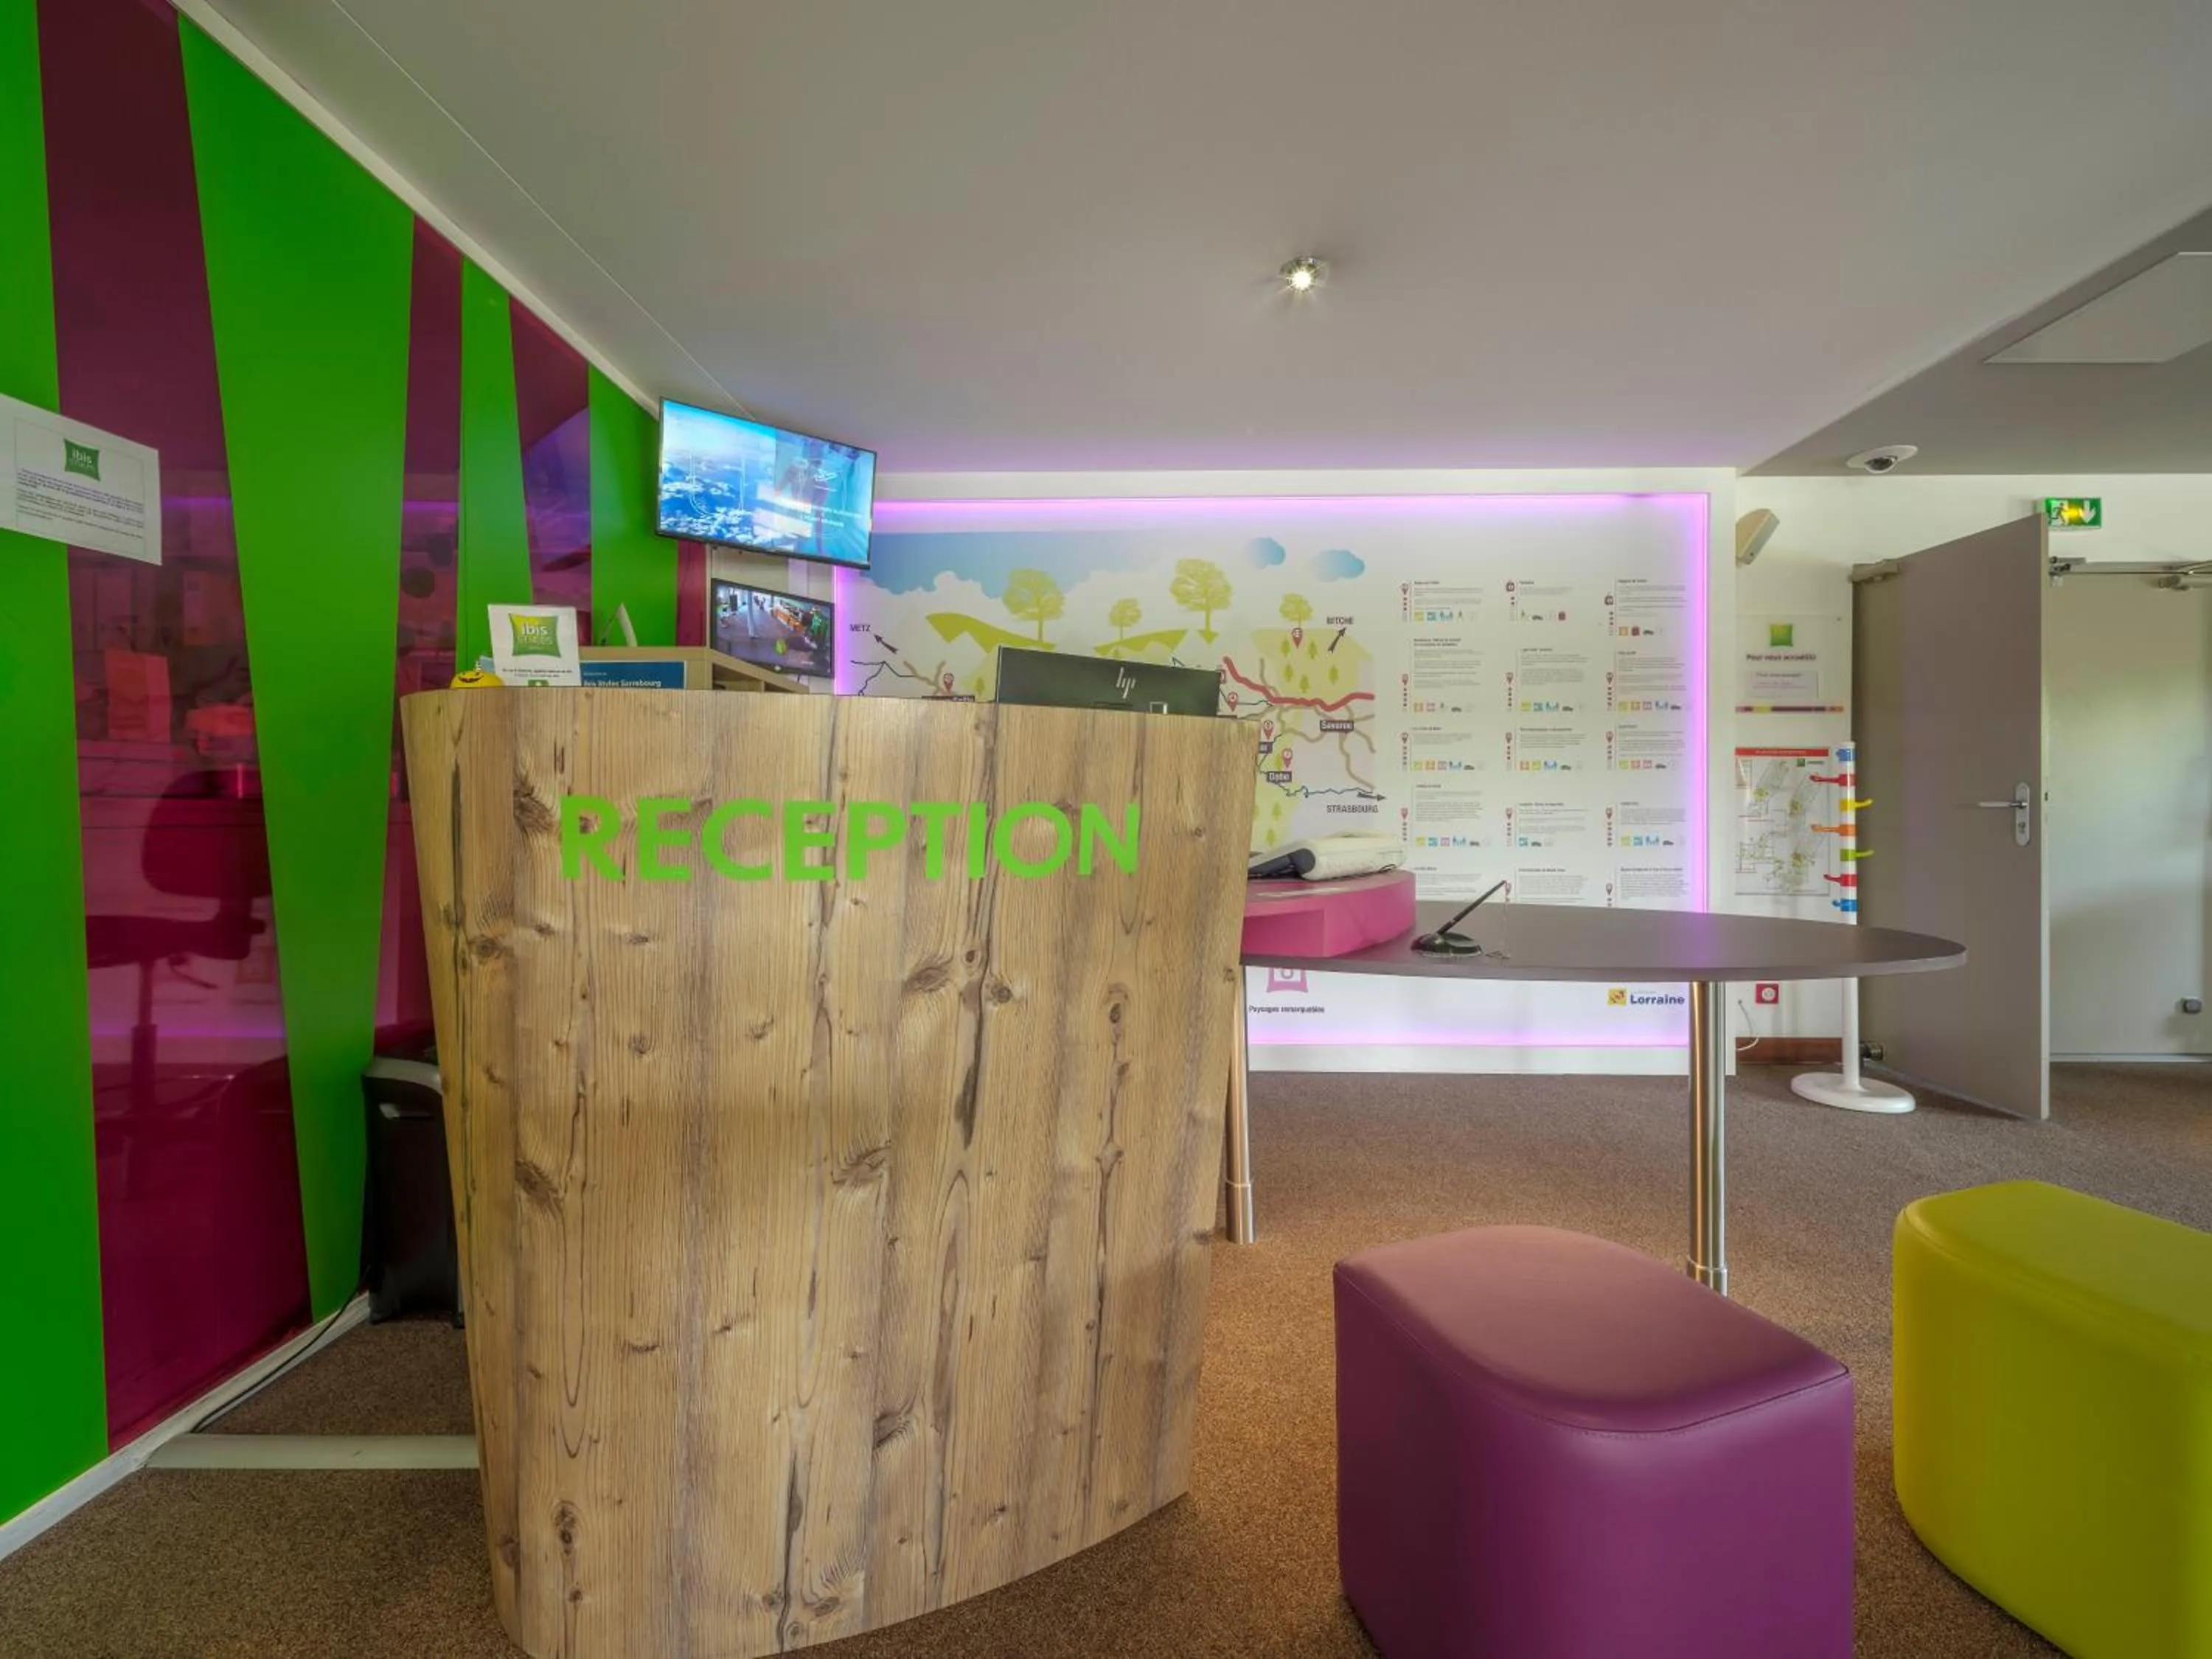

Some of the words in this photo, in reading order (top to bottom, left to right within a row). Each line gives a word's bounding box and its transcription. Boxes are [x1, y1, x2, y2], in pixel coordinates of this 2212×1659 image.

[72, 449, 92, 465] ibis
[1326, 616, 1354, 625] BITCHE
[522, 622, 548, 636] ibis
[849, 624, 871, 632] METZ
[620, 678, 662, 688] Sarrebourg
[1116, 666, 1136, 700] hp
[1321, 720, 1352, 729] Saverne
[1269, 772, 1290, 782] Dabo
[1326, 804, 1379, 813] STRASBOURG
[560, 795, 1140, 881] RECEPTION
[1630, 993, 1685, 1004] Lorraine
[1249, 1005, 1279, 1013] Paysages
